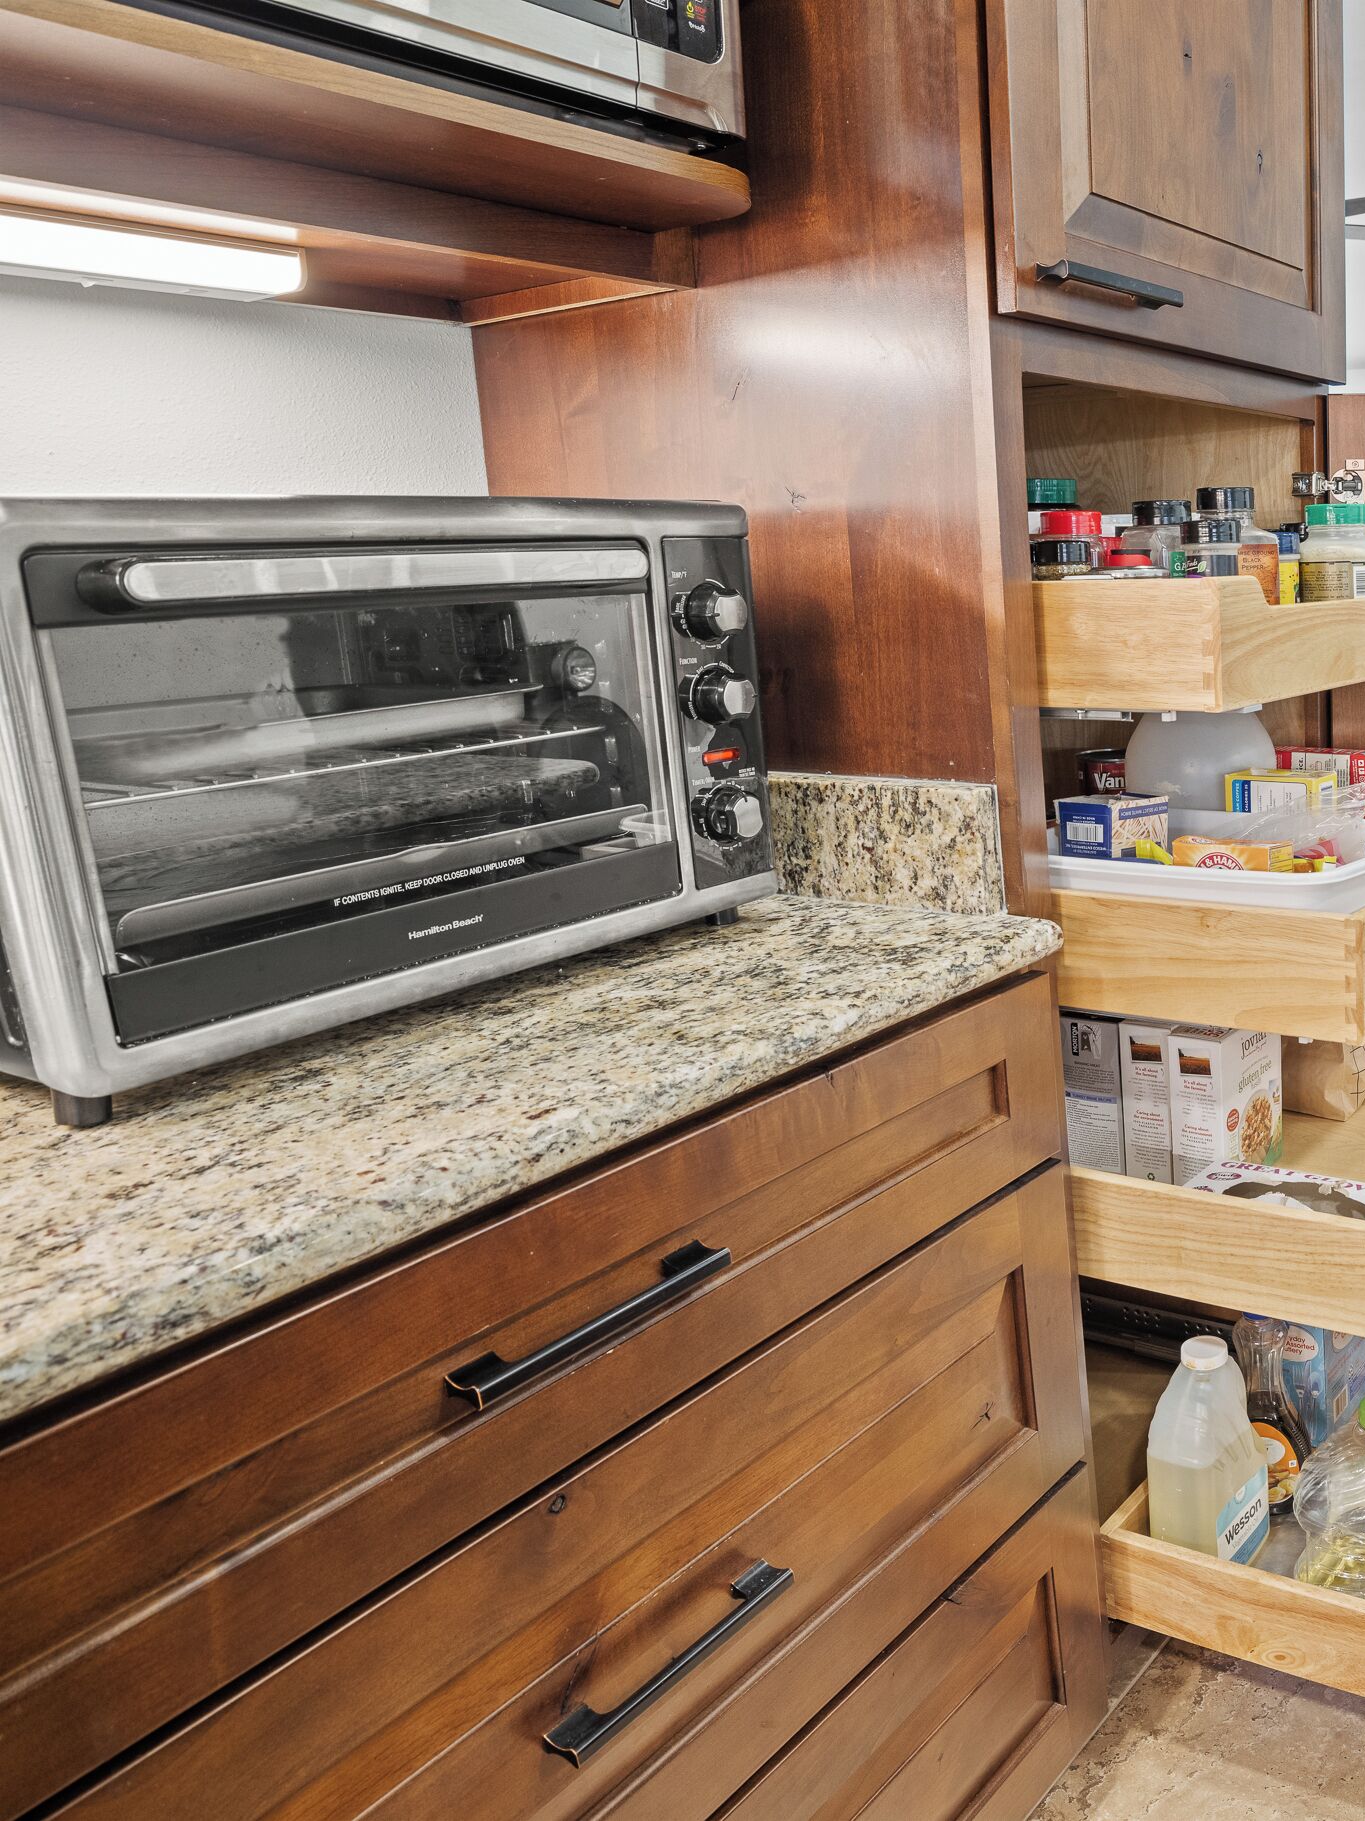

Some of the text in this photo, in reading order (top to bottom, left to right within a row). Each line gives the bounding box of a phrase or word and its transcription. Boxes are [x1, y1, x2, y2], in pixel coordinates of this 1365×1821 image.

[1205, 858, 1213, 866] &
[334, 856, 525, 907] IF CONTENTS IGNITE, KEEP DOOR CLOSED AND UNPLUG OVEN
[408, 915, 482, 940] Hamilton Beach
[1238, 1068, 1259, 1093] gluten
[1260, 1060, 1272, 1075] free
[1221, 1161, 1294, 1176] GREAT
[1286, 1340, 1315, 1351] Assorted
[1225, 1498, 1262, 1545] Wesson
